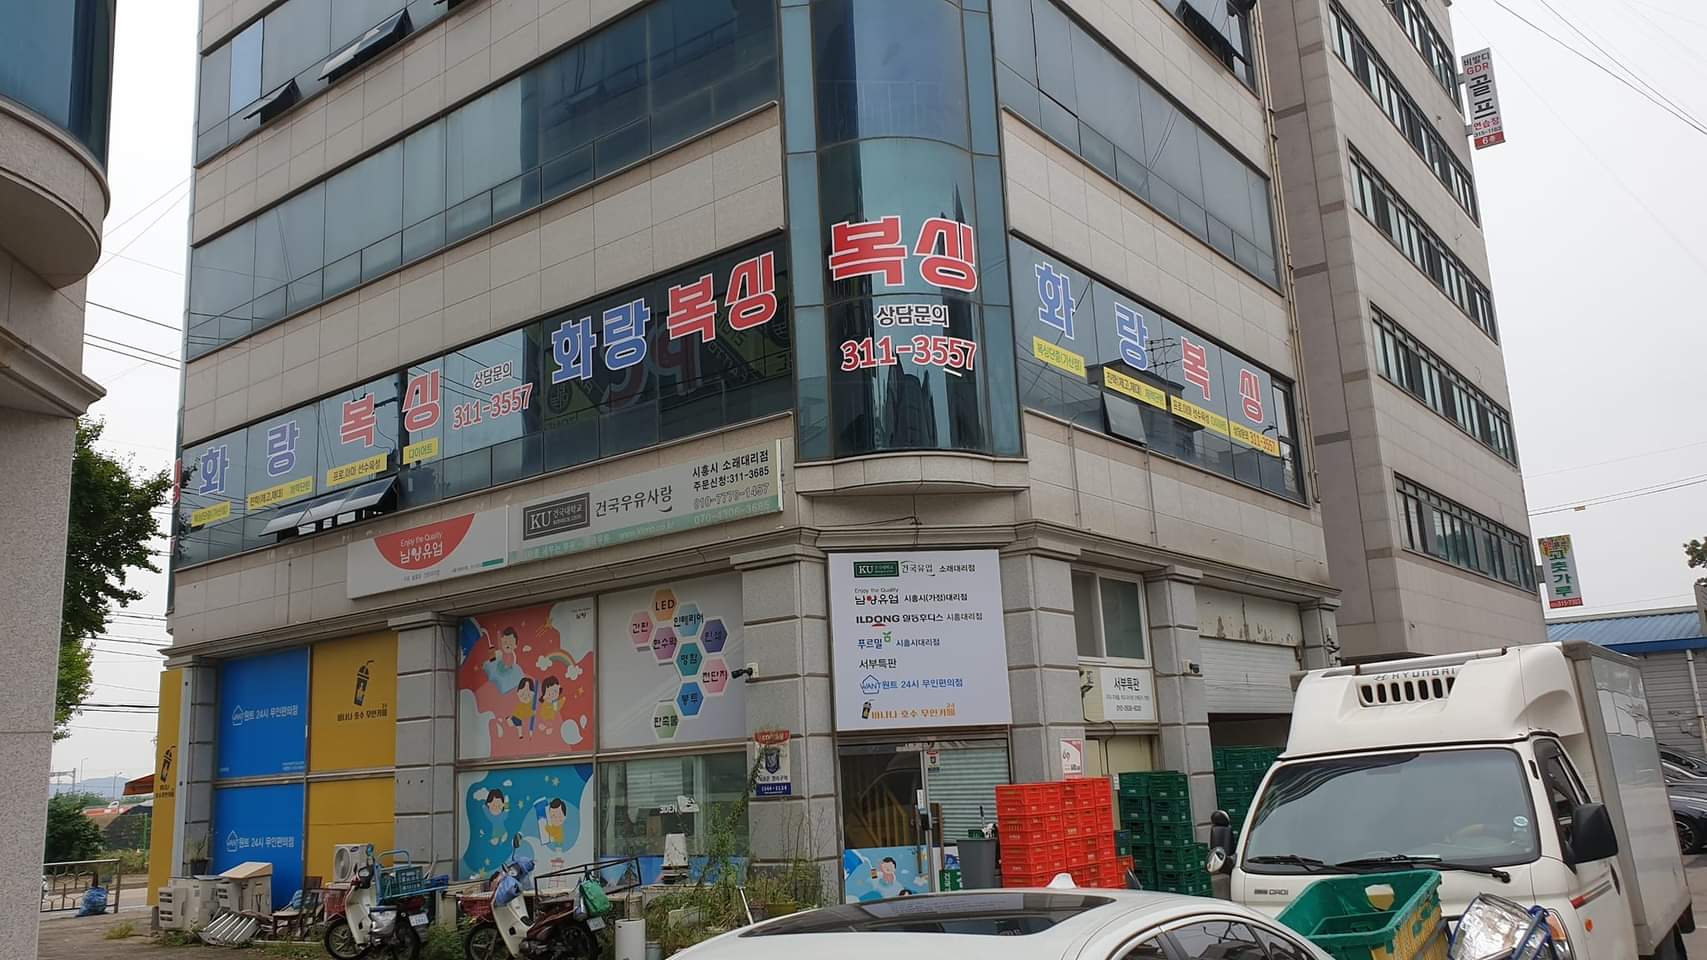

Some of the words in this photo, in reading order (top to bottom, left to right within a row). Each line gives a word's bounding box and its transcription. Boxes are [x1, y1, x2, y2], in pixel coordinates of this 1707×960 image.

[1466, 63, 1489, 75] GDR
[1469, 74, 1497, 120] 골프
[829, 215, 978, 293] 복싱
[551, 298, 651, 385] 화랑
[667, 250, 778, 344] 복싱
[875, 304, 950, 328] 상담문의
[840, 334, 977, 372] 311-3557
[473, 360, 512, 389] 상담문의
[453, 382, 534, 431] 311-3557
[408, 442, 433, 460] 다이어트
[692, 461, 718, 478] 시흥시
[722, 449, 769, 471] 소래대리점
[693, 465, 770, 492] 주문신청:311-3685
[595, 485, 673, 517] 건국우유사랑
[530, 511, 552, 530] KU
[400, 536, 415, 548] Enjoy
[399, 541, 443, 565] 남양유업
[858, 565, 874, 575] KU
[938, 564, 976, 574] 소래대리점
[655, 600, 675, 612] LED
[854, 593, 899, 606] 남양유업
[903, 593, 968, 604] 시흥시(가정)대리점
[673, 612, 704, 629] 인테리어
[856, 614, 900, 624] ILDONG
[902, 613, 944, 623] 일동후디스
[946, 612, 984, 622] 시흥대리점
[632, 621, 649, 635] 간판
[653, 637, 678, 650] 현수막
[857, 638, 883, 650] 푸르밀
[895, 638, 940, 648] 시흥시대리점
[680, 652, 698, 666] 명함
[859, 657, 897, 670] 서부특판
[702, 669, 728, 684] 전단지
[1392, 667, 1456, 680] HYUNDAI
[881, 680, 898, 690] 원트
[900, 679, 920, 689] 24시
[922, 678, 964, 689] 무인편의점
[1114, 677, 1140, 692] 서부특판
[681, 692, 699, 706] 봉투
[255, 709, 269, 720] 24시
[653, 713, 679, 729] 판촉물
